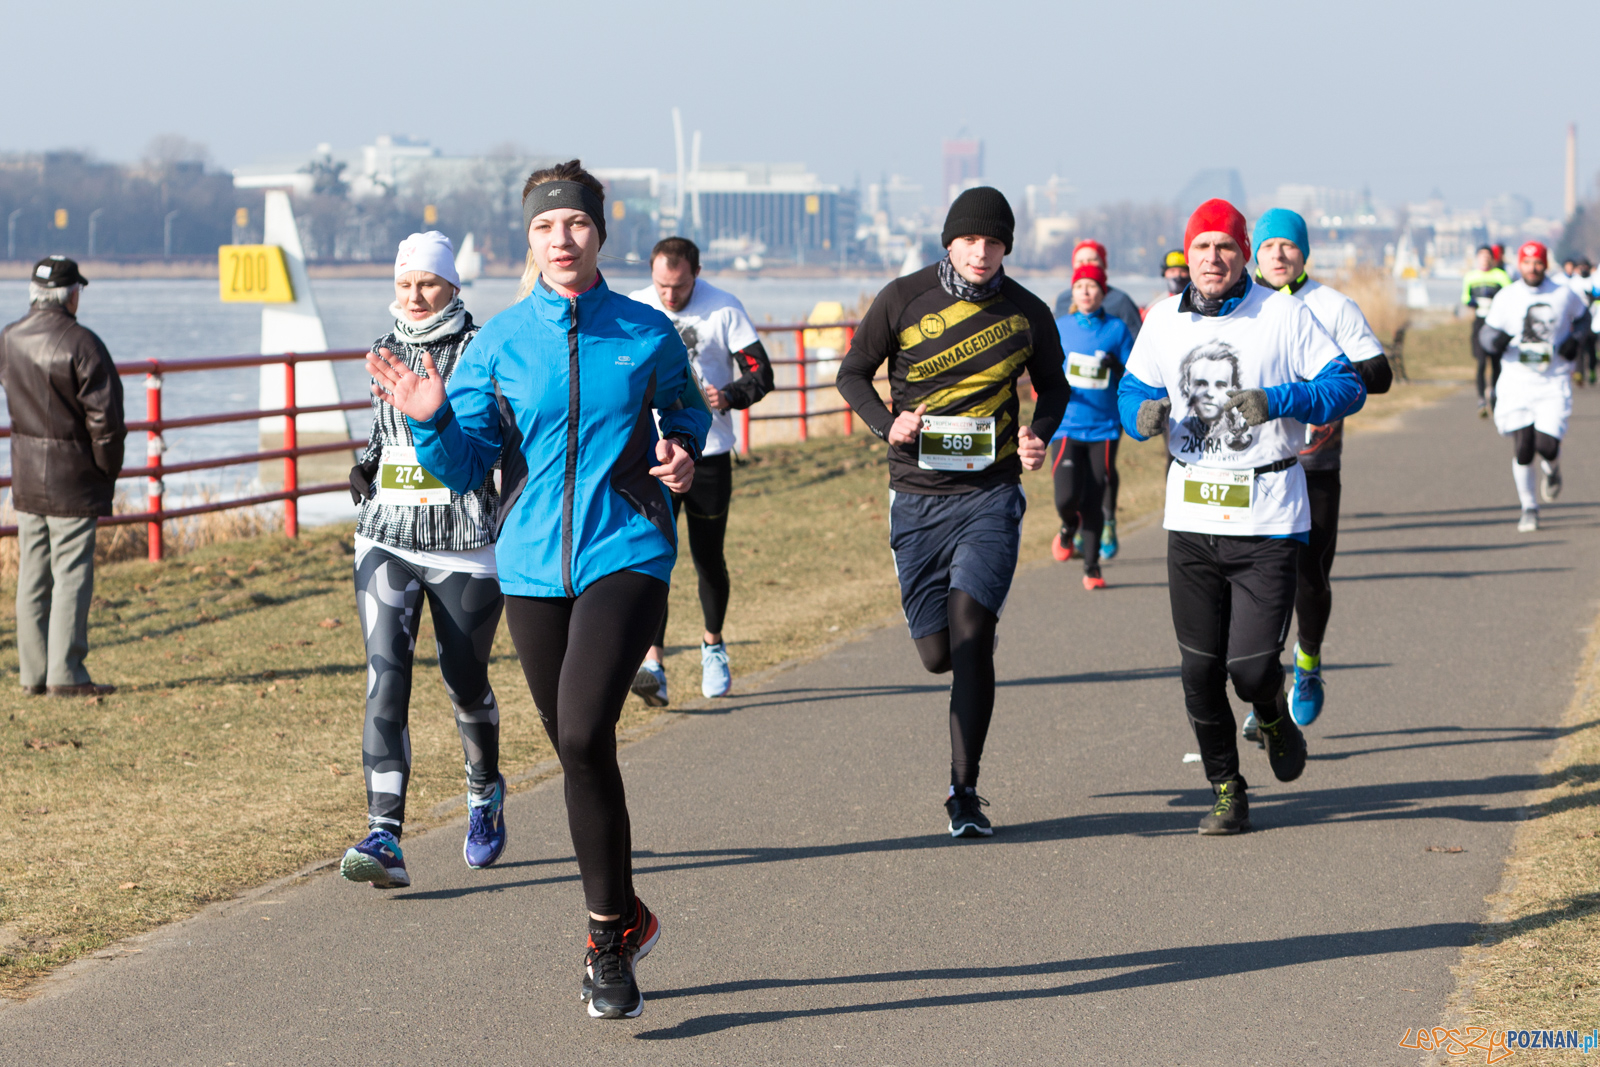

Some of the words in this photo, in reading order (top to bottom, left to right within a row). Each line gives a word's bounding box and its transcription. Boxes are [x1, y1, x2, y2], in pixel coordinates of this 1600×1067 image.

[548, 188, 562, 196] 4F
[231, 252, 268, 291] 200
[916, 320, 1013, 377] RUNMAGEDDON
[942, 434, 973, 450] 569
[395, 466, 424, 483] 274
[1200, 483, 1230, 501] 617
